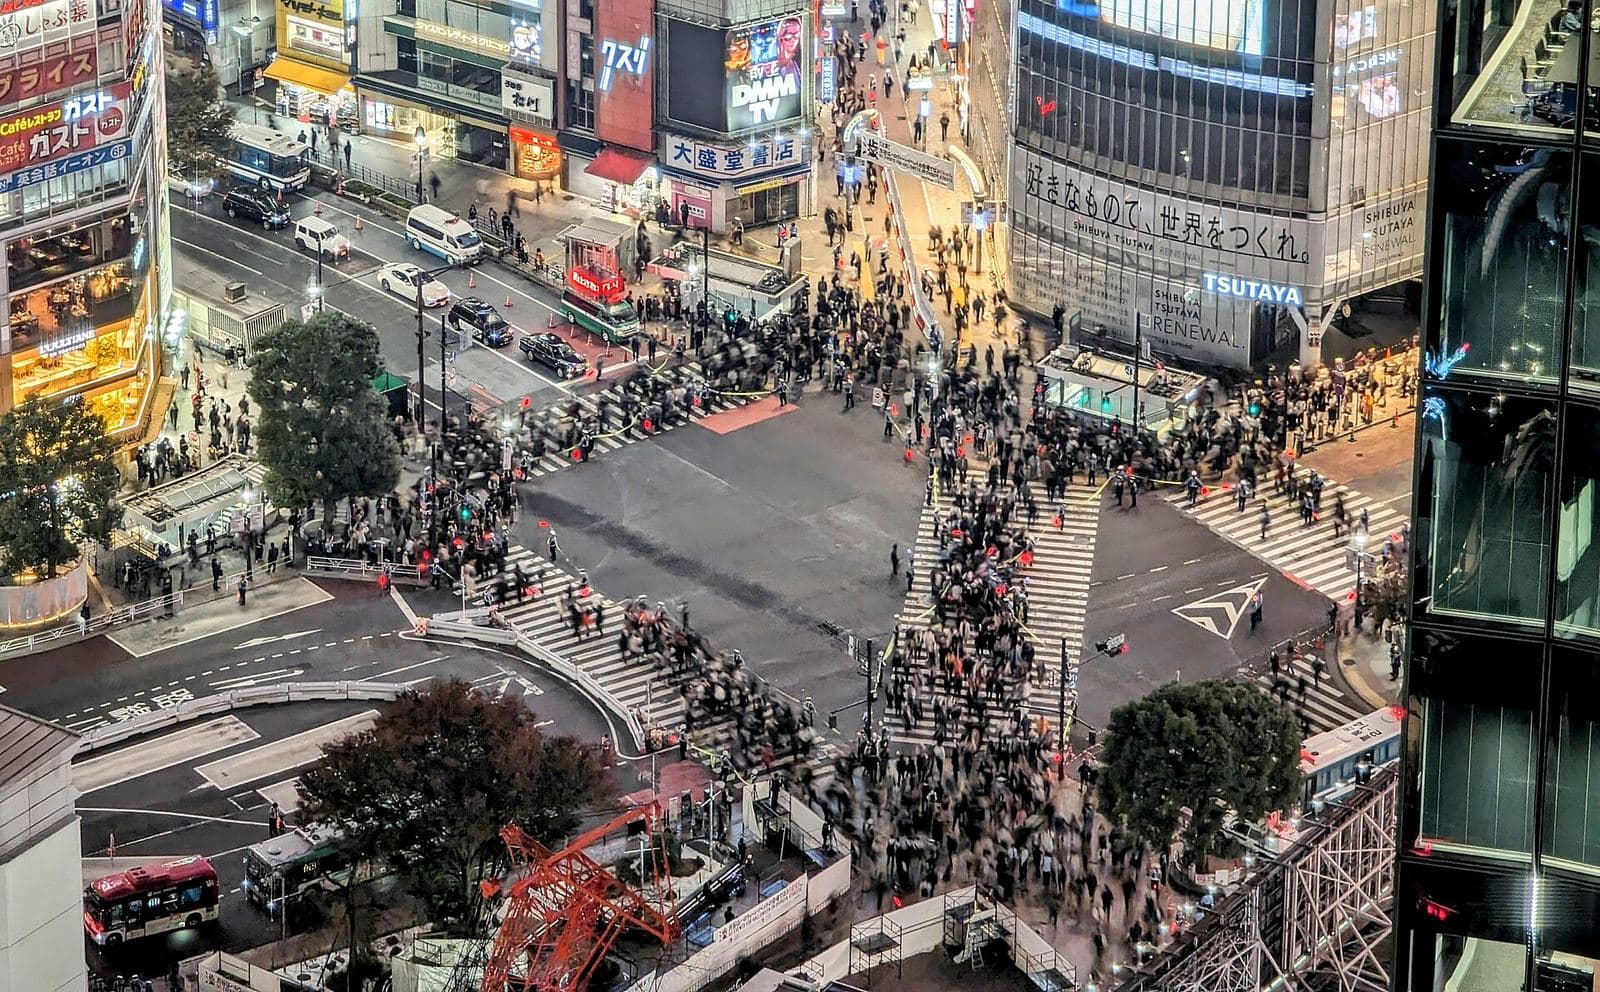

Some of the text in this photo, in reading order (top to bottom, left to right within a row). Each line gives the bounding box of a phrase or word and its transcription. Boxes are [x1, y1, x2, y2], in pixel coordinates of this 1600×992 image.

[26, 0, 88, 35] しゃぶ葉
[732, 72, 797, 107] DMM
[63, 91, 113, 121] ガスト
[749, 98, 780, 124] TV
[29, 122, 89, 161] ガスト
[673, 139, 794, 171] 大盛堂書店
[17, 150, 106, 188] 英会話イーオン
[1027, 162, 1309, 265] 好きなもので、世界をつくれ。
[1365, 217, 1414, 239] SUTAYA
[1366, 200, 1415, 224] SHIBUYA
[1073, 221, 1111, 239] SHIBUYA
[1115, 233, 1154, 251] TSUTAYA
[1203, 273, 1302, 305] TSUTAYA
[1154, 302, 1200, 320] TSUTAYA
